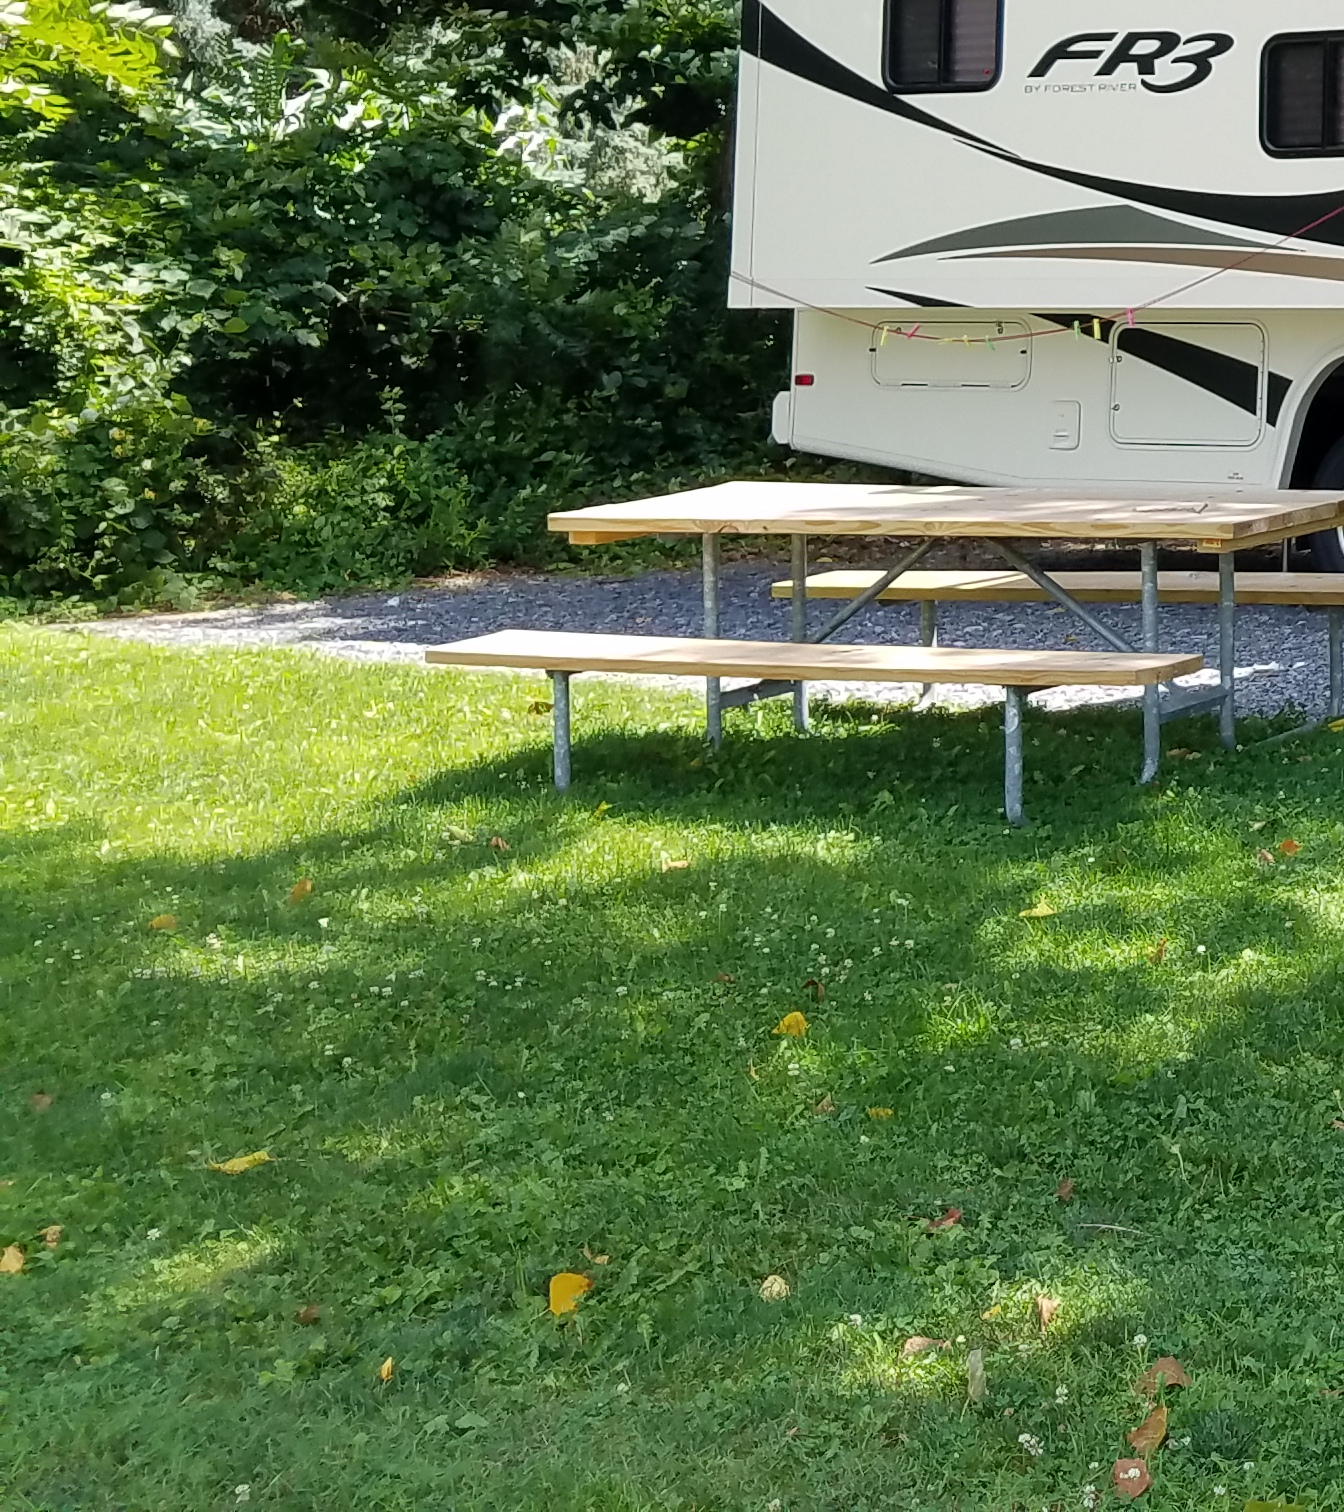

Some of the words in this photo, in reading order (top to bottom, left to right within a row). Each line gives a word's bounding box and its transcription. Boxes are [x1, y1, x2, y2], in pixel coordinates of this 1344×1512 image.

[1026, 31, 1235, 94] FR3
[1023, 84, 1041, 94] BY
[1043, 83, 1095, 93] FOREST
